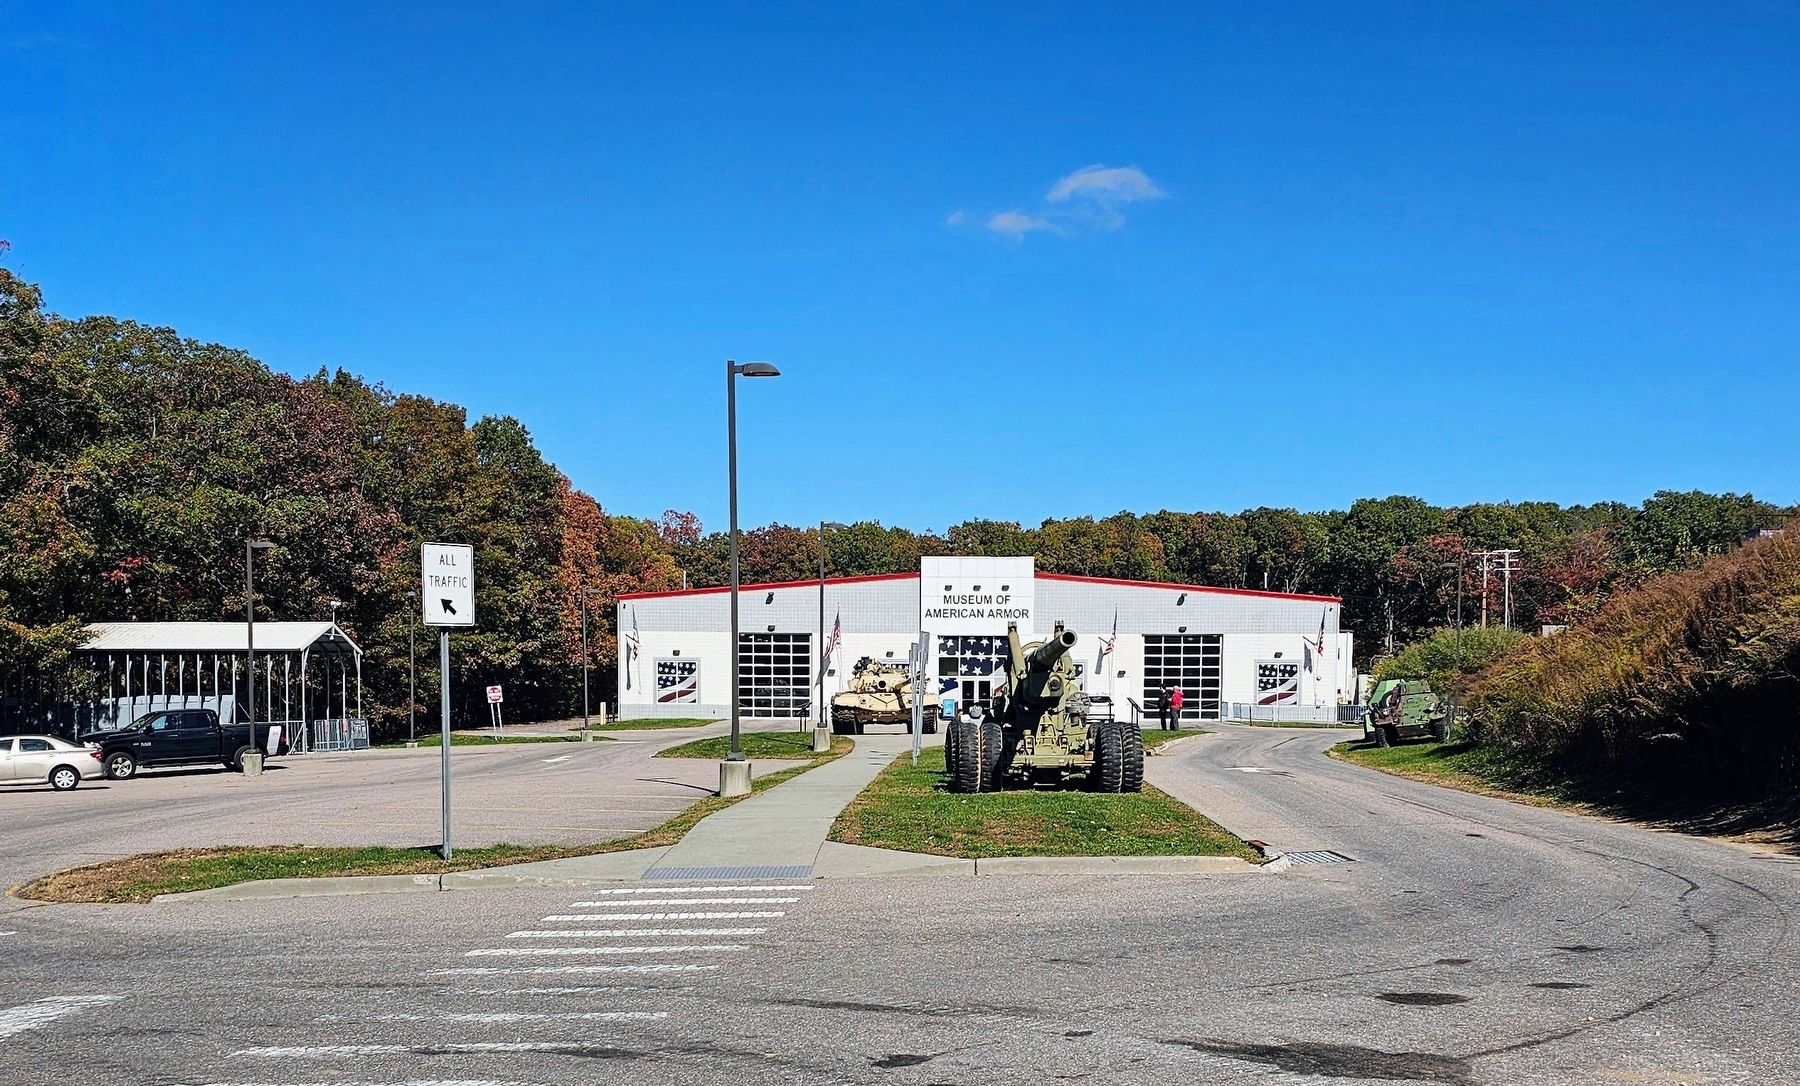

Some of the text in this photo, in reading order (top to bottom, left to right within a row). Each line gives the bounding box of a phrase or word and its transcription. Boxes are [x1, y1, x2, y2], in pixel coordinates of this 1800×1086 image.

[439, 554, 456, 566] ALL
[429, 575, 468, 588] TRAFFIC
[943, 595, 1011, 605] MUSEUM OF
[925, 608, 1029, 618] AMERICAN ARMOR
